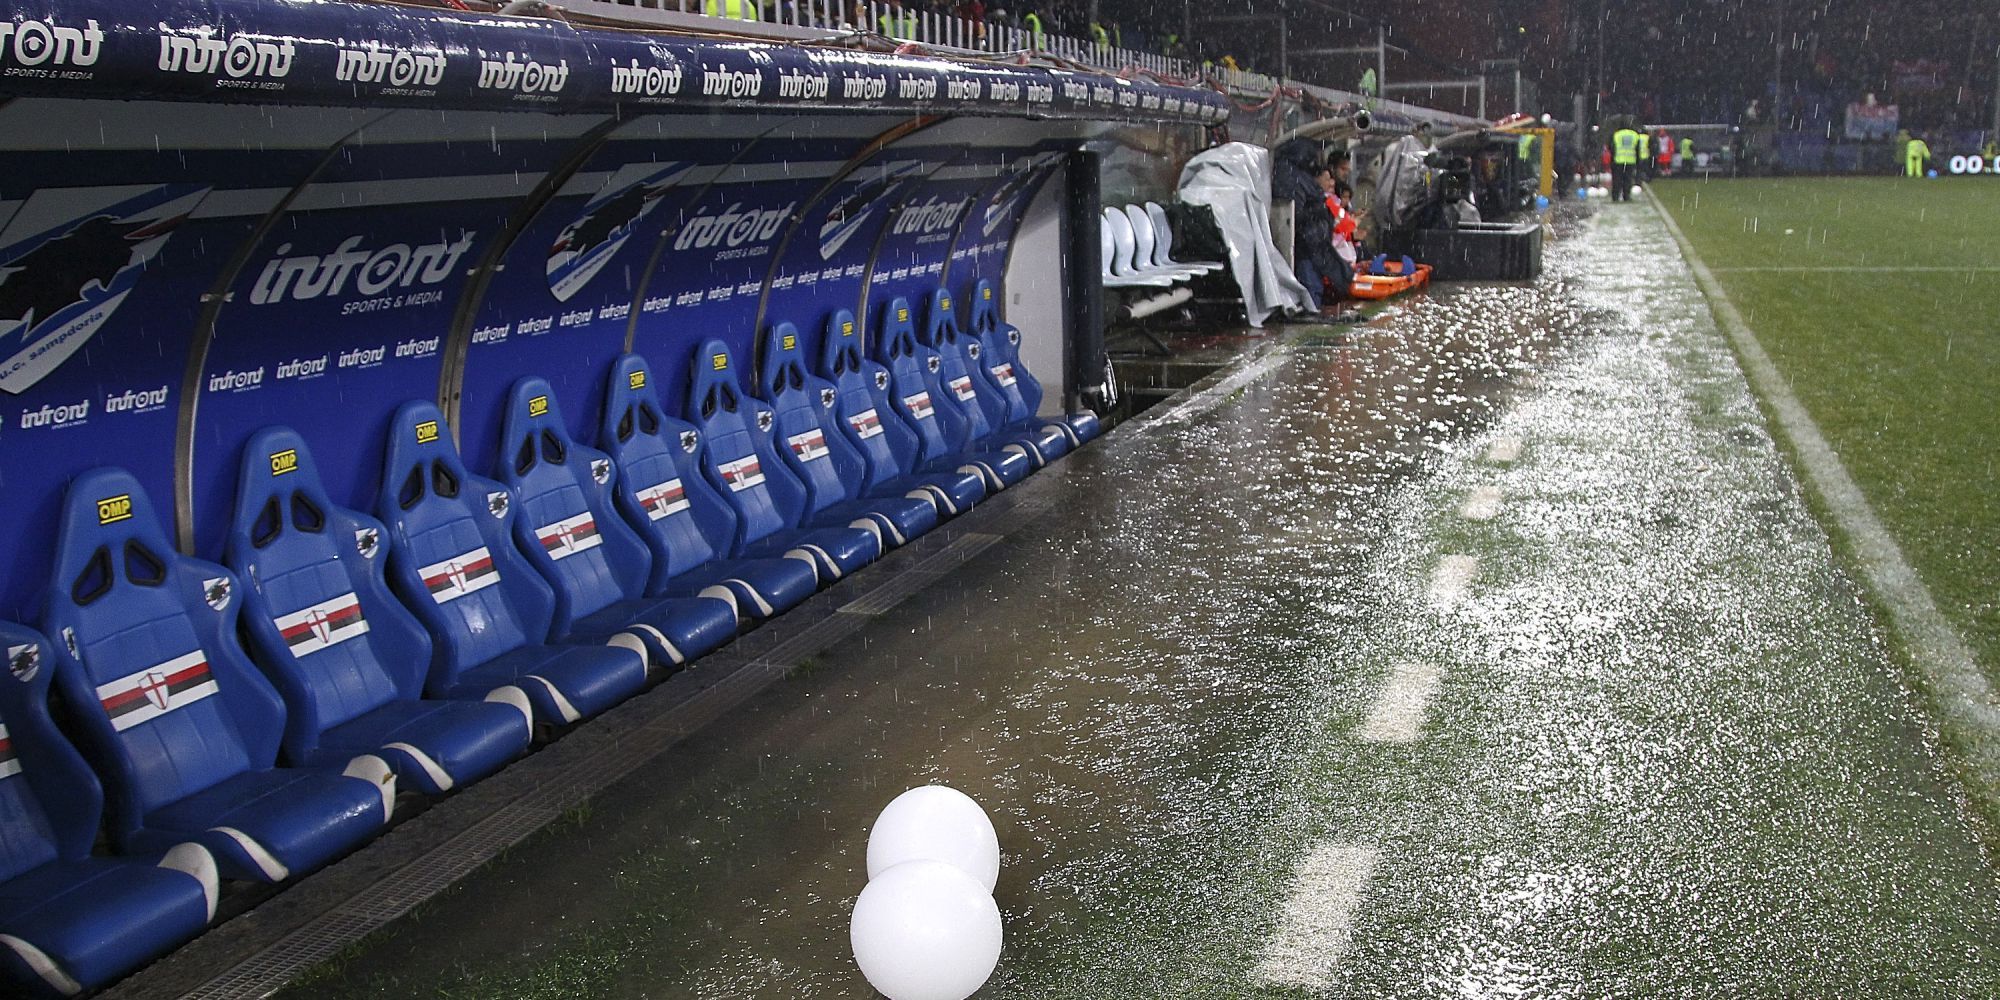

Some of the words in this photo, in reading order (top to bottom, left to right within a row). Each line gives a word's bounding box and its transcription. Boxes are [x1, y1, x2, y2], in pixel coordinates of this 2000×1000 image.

[159, 21, 295, 78] infront
[336, 37, 447, 86] infront
[4, 67, 48, 79] SPORTS
[49, 70, 58, 79] &
[59, 70, 94, 80] MEDIA
[478, 48, 569, 93] infront
[611, 58, 682, 96] infront
[702, 63, 762, 98] infront
[779, 68, 829, 99] infront
[216, 79, 251, 89] SPORTS
[251, 81, 258, 89] &
[259, 81, 285, 91] MEDIA
[380, 87, 408, 97] SPORTS
[415, 89, 437, 97] MEDIA
[674, 201, 797, 251] infront
[250, 231, 476, 305] infront
[341, 297, 392, 315] SPORTS
[393, 295, 403, 308] &
[404, 290, 443, 307] MEDIA
[29, 311, 103, 361] sampdoria
[395, 336, 439, 358] infront
[276, 355, 328, 379] infront
[338, 345, 385, 368] infront
[209, 367, 264, 392] infront
[106, 385, 168, 413] infront
[21, 400, 89, 429] infront
[416, 424, 438, 440] OMP
[271, 453, 297, 471] OMP
[99, 499, 131, 519] OMP
